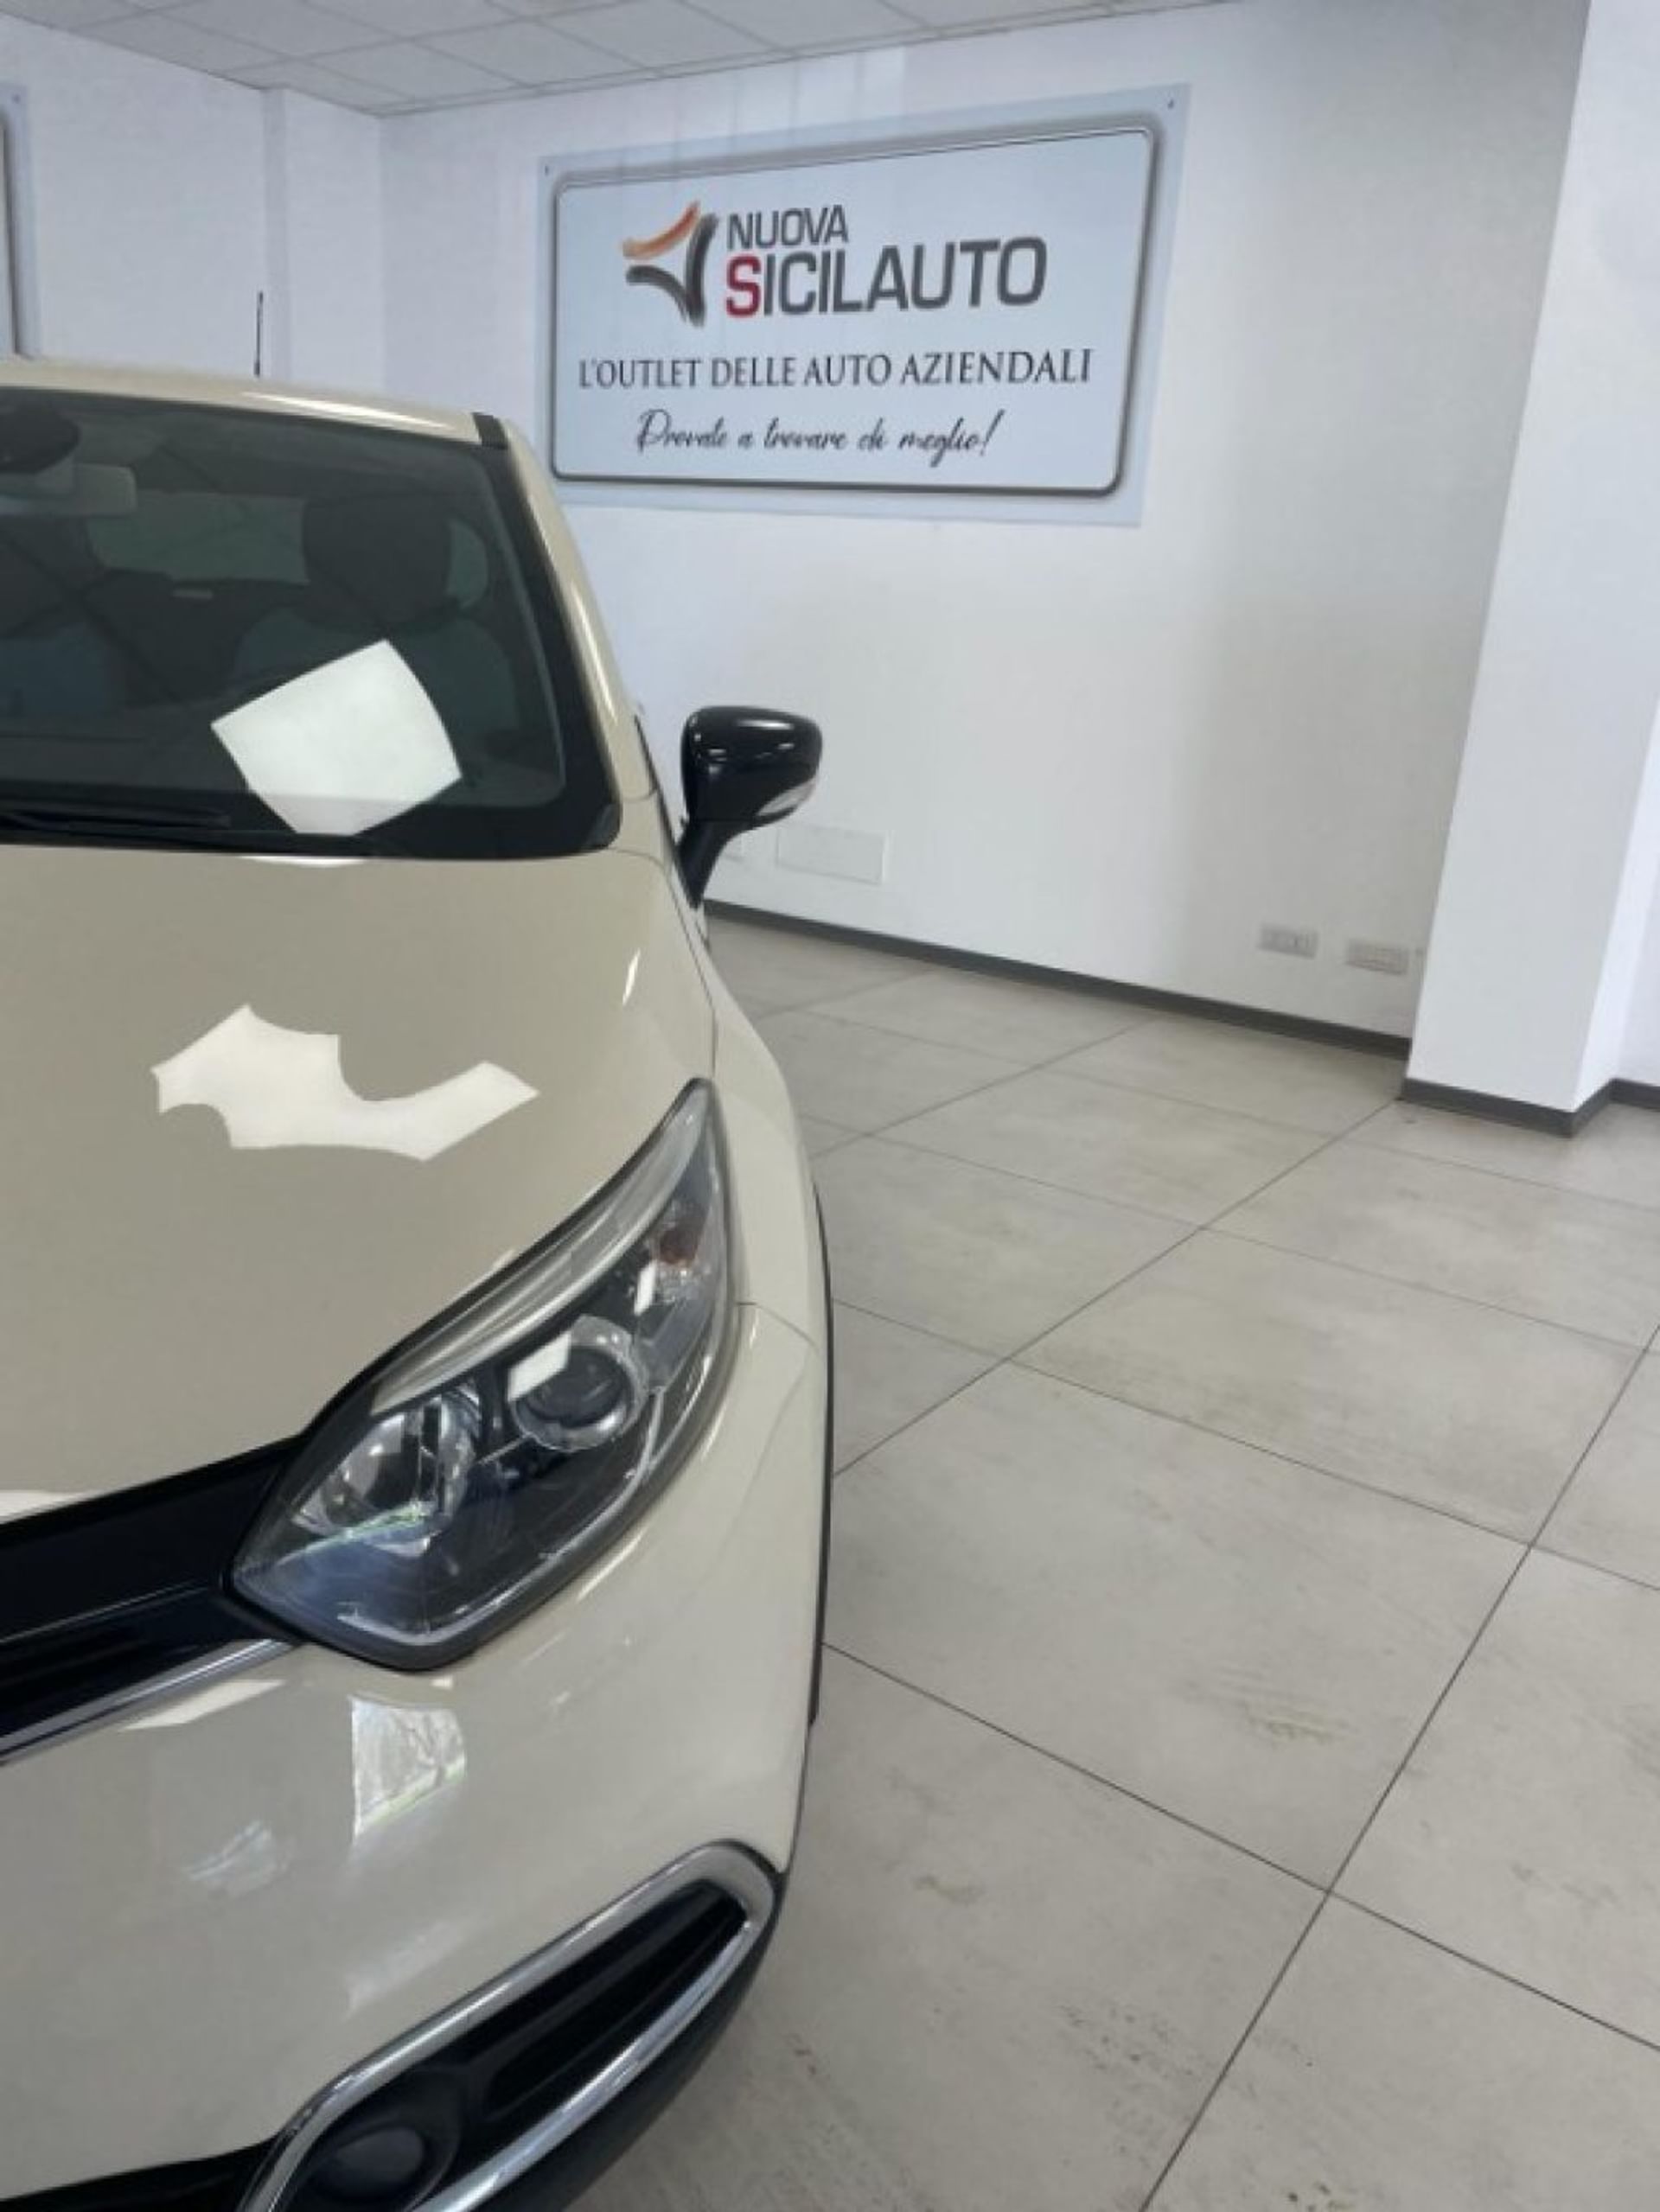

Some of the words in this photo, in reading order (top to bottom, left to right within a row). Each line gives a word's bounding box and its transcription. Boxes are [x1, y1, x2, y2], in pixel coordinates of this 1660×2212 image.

[726, 204, 849, 250] NUOVA
[725, 236, 1047, 317] SICILAUTO
[578, 358, 701, 389] L'OUTLET
[712, 356, 797, 388] DELLE
[804, 354, 892, 387] AUTO
[899, 348, 1093, 386] AZIENDALI
[635, 409, 727, 454] Provate
[737, 429, 754, 450] a
[763, 417, 849, 452] trovare
[859, 418, 888, 452] di
[898, 410, 1006, 468] meglio!
